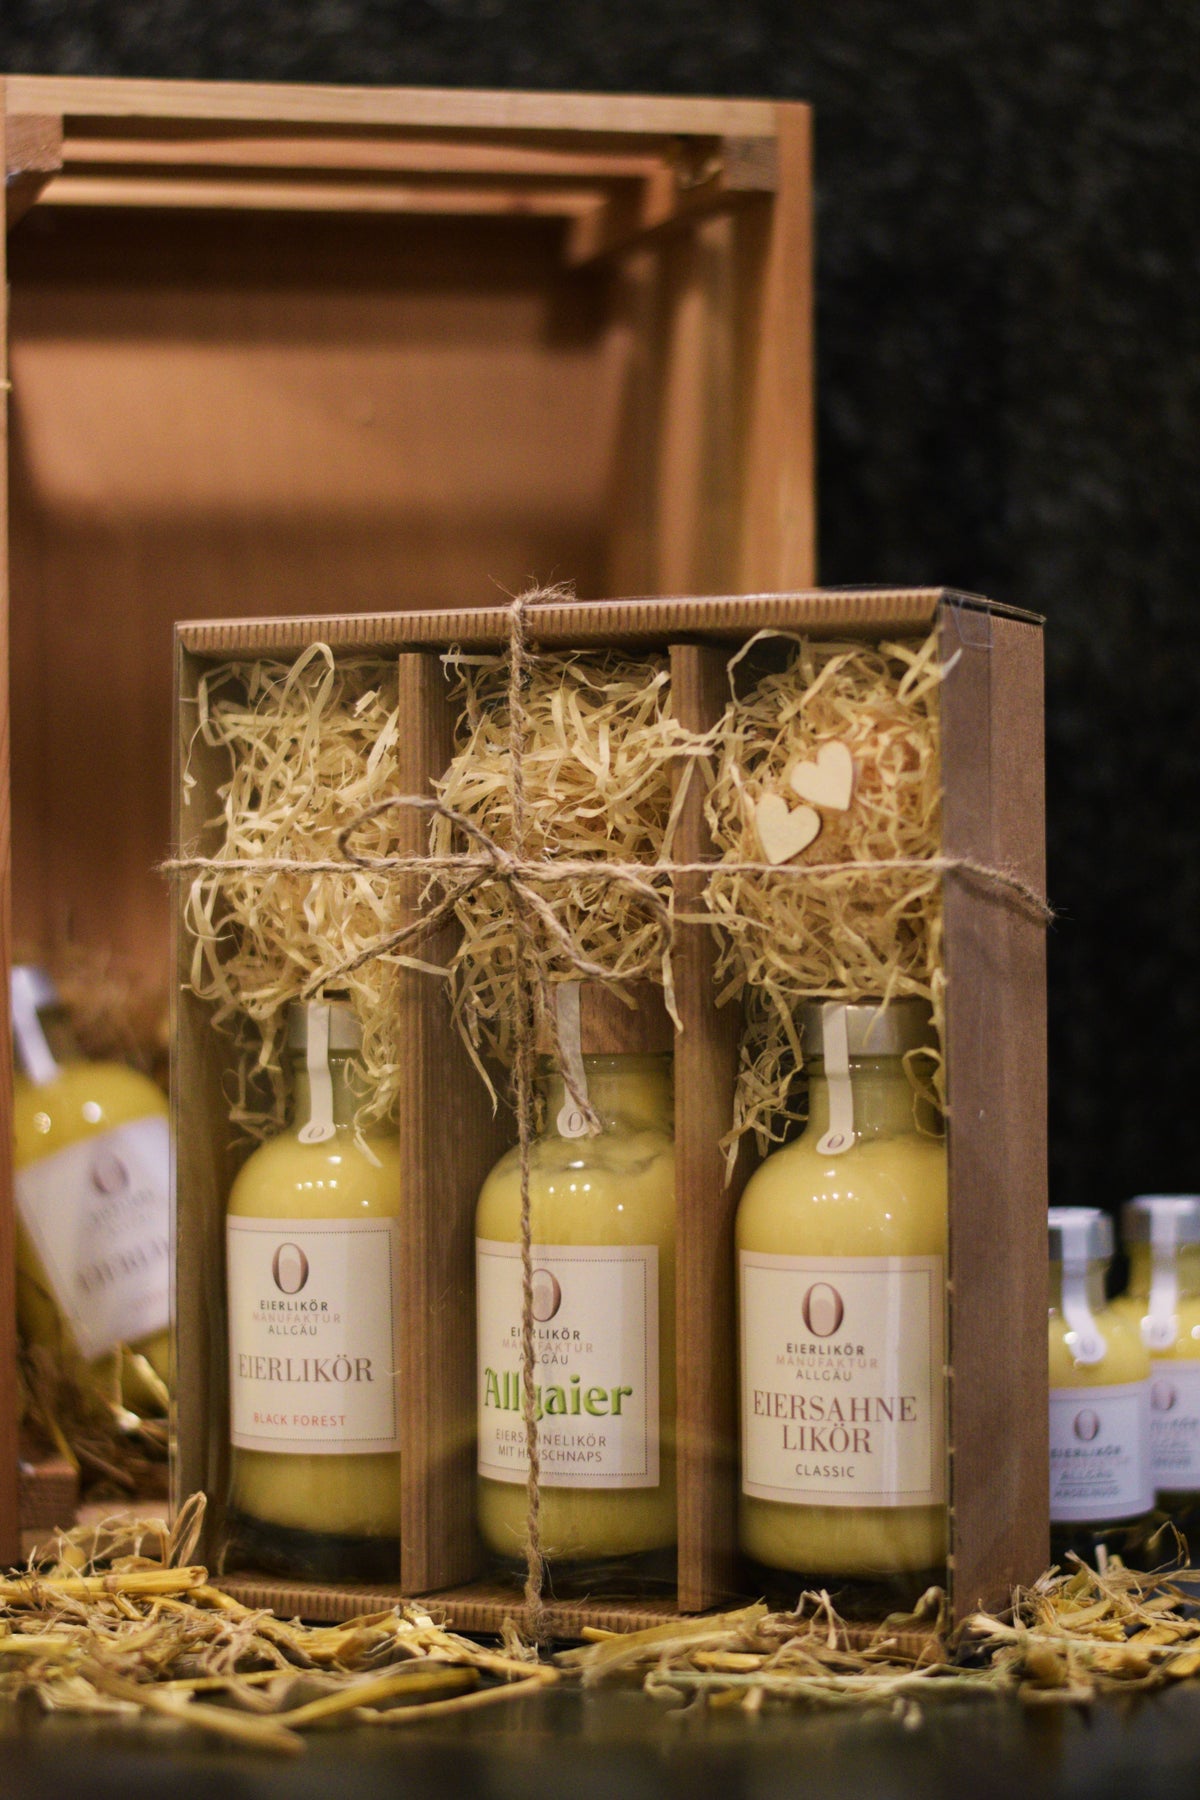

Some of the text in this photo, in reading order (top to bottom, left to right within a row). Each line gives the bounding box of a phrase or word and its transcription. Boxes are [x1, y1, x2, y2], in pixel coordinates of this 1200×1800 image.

[272, 1242, 310, 1295] O
[260, 1299, 329, 1312] EIERLIKÖR
[802, 1282, 844, 1338] O
[252, 1311, 341, 1324] MANUFAKTUR
[268, 1323, 318, 1336] ALLGÄU
[786, 1342, 864, 1356] EIERLIKÖR
[238, 1353, 375, 1383] EIERLIKÖR
[776, 1355, 880, 1369] MANUFAKTUR
[795, 1368, 852, 1382] ALLGÄU
[753, 1389, 917, 1422] EIERSAHNE
[253, 1412, 346, 1427] BLACK FOREST
[782, 1422, 872, 1454] LIKÖR
[498, 1445, 515, 1457] MIT
[795, 1464, 856, 1478] CLASSIC
